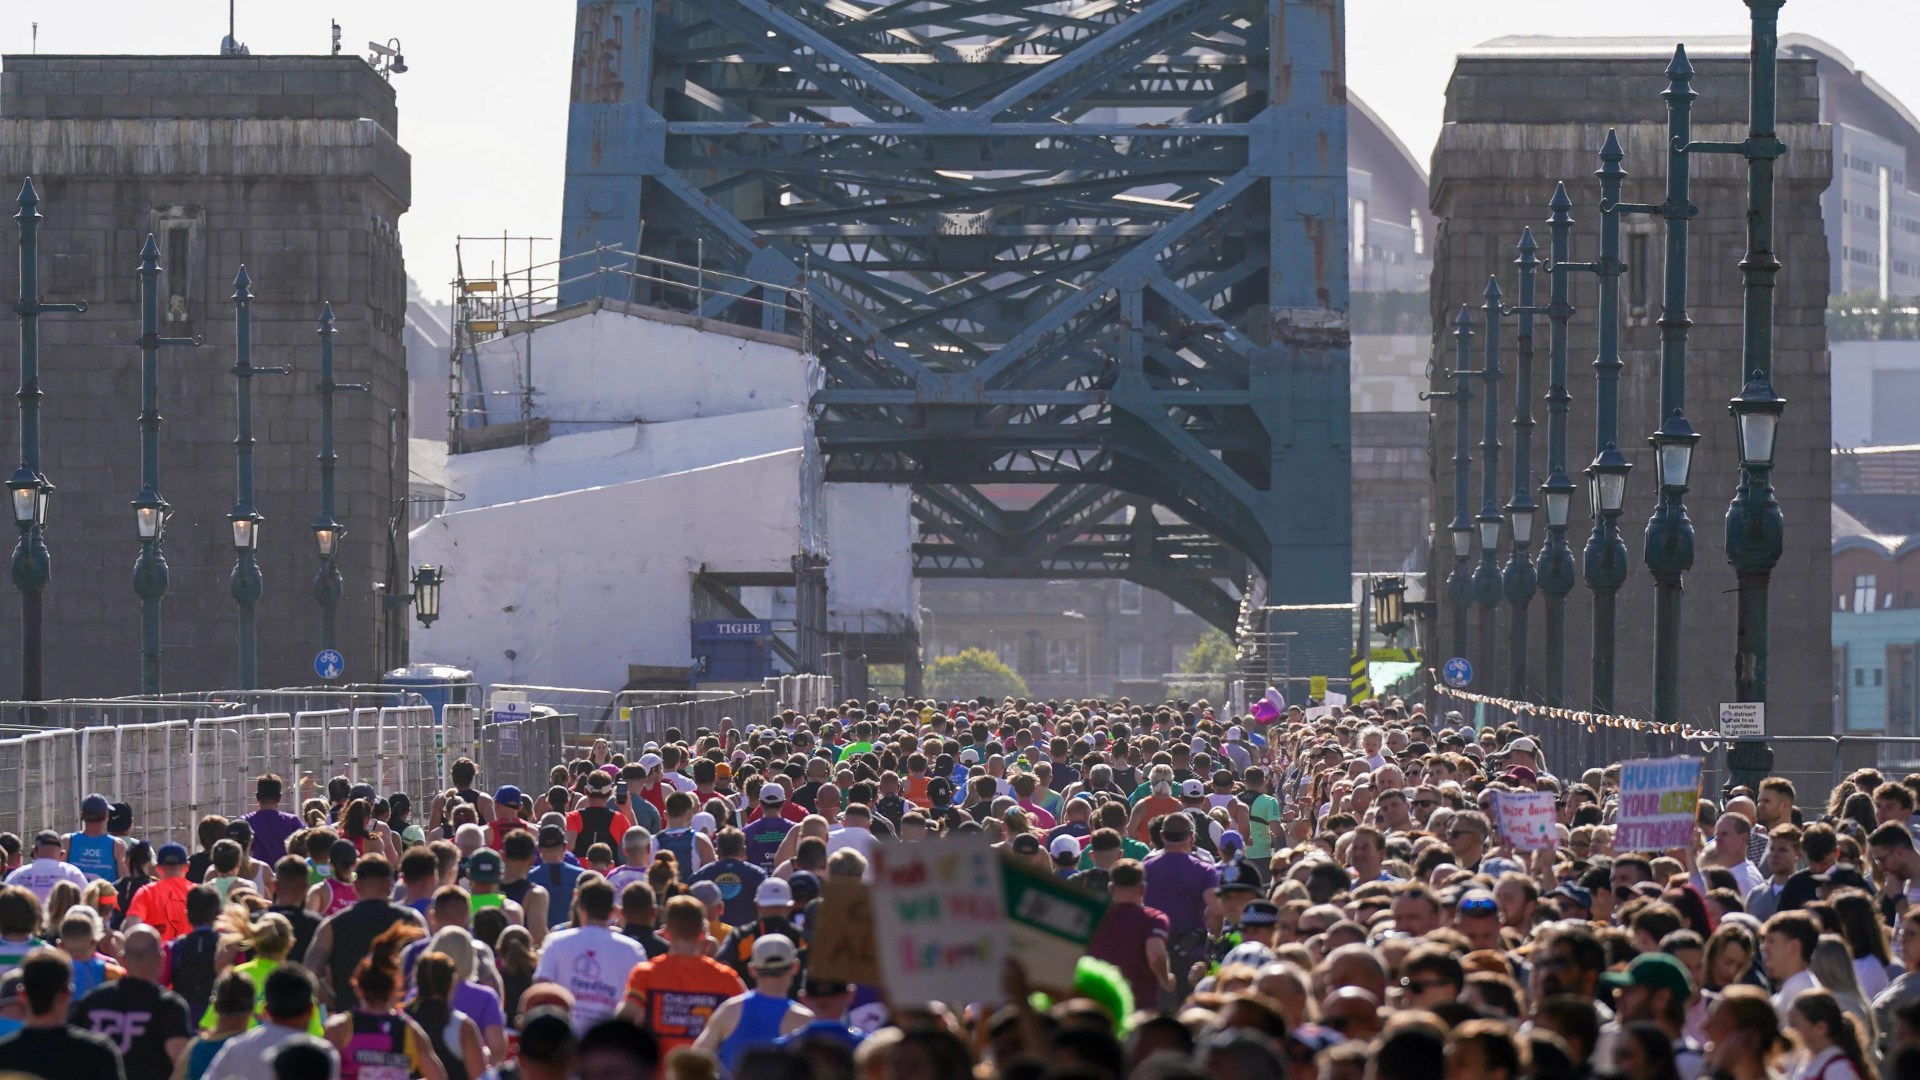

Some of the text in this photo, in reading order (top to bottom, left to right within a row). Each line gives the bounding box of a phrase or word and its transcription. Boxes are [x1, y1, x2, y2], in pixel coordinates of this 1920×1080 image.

[717, 623, 761, 634] TIGHE
[1622, 793, 1660, 816] YOUR
[82, 848, 102, 857] JOE
[663, 993, 716, 1005] CHILDREN
[663, 1015, 705, 1024] CANCER
